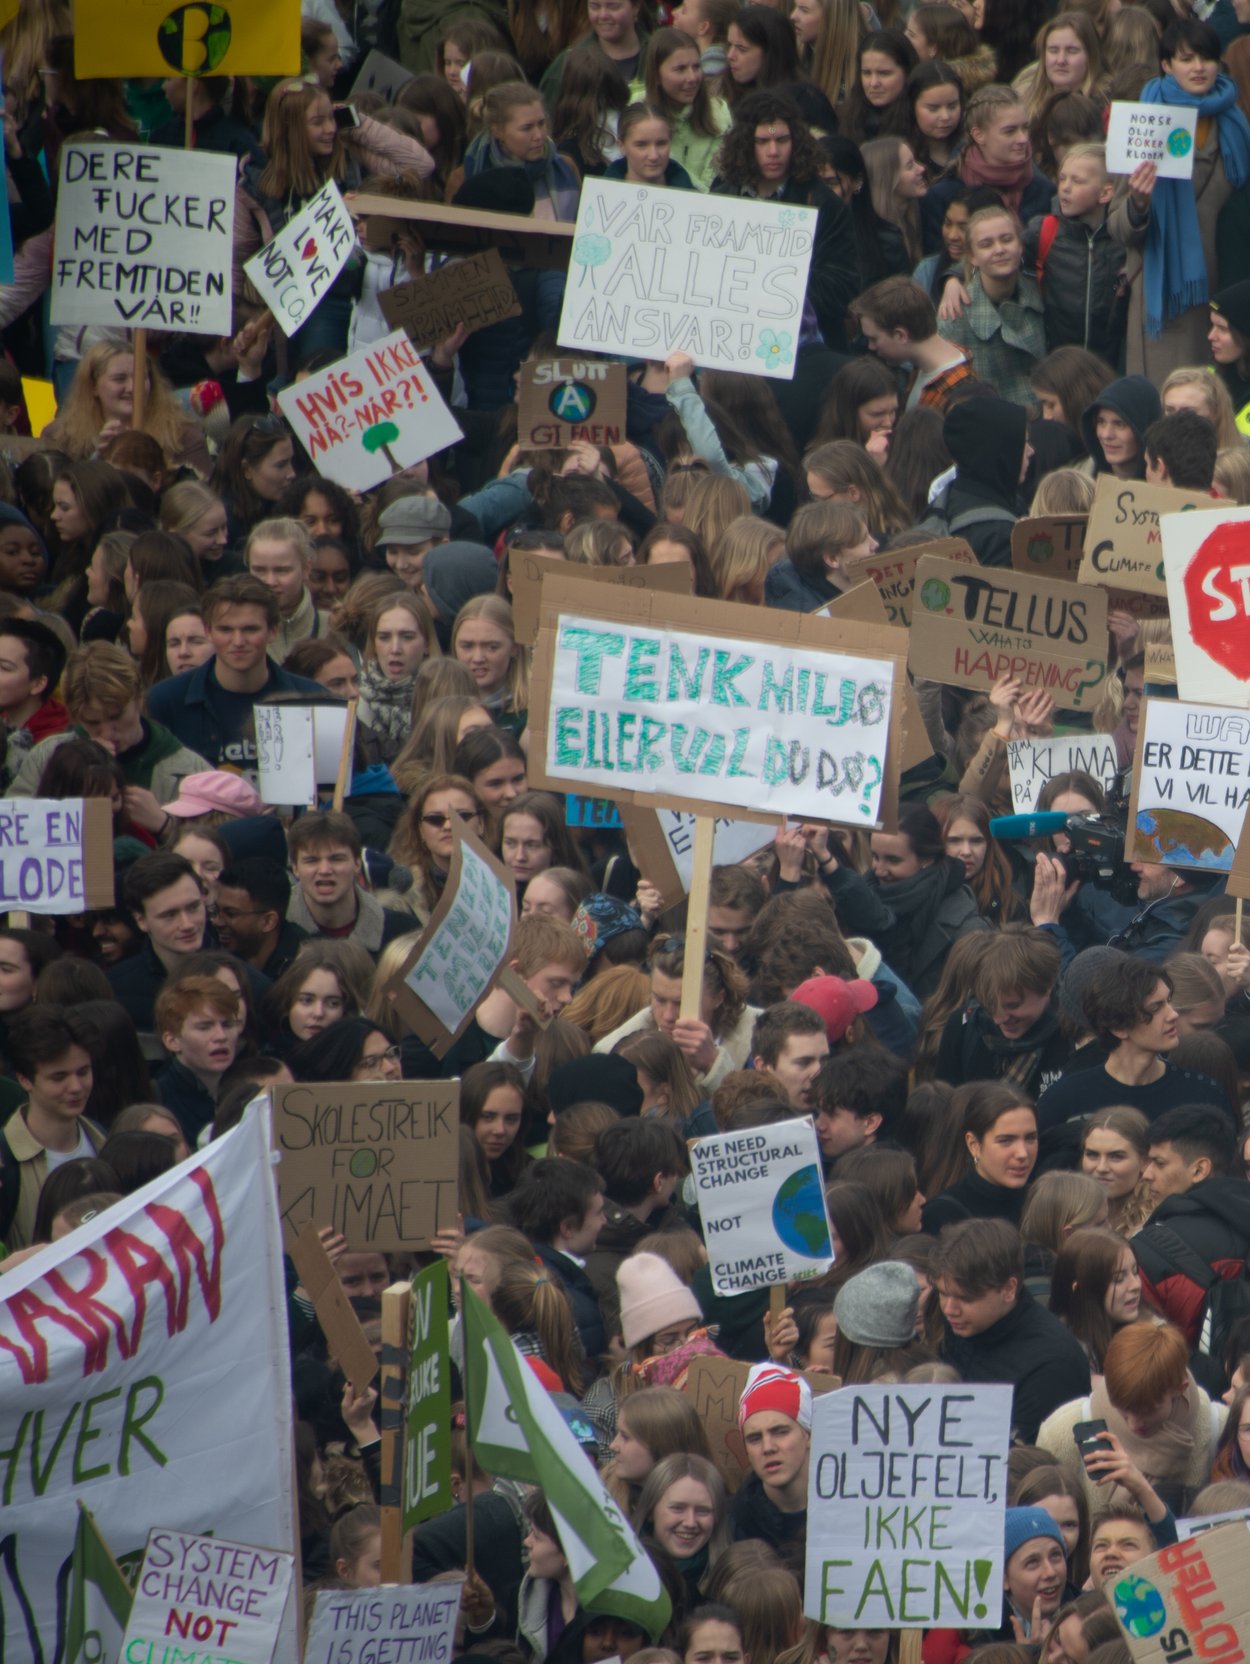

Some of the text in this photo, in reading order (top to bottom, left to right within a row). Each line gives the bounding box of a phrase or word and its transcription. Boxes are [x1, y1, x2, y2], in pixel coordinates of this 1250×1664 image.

[1127, 138, 1164, 149] KOKER
[65, 150, 161, 183] DERE
[92, 188, 227, 235] FUCKER
[307, 188, 351, 261] MAKE
[597, 189, 813, 258] VÅR FRAMTID
[74, 224, 153, 255] MED
[57, 259, 224, 296] FREMTIDEN
[257, 241, 295, 288] NOT
[602, 243, 800, 320] ALLES
[573, 296, 754, 361] ANSVAR!
[296, 338, 423, 428] HVIS IKKE
[532, 360, 610, 385] SLUTT
[557, 379, 588, 417] Å
[530, 425, 561, 445] GI
[866, 562, 904, 584] DET
[1091, 540, 1152, 573] CLIMATE
[951, 575, 1088, 644] TELLUS
[559, 627, 886, 728] TENK MILJØ
[555, 706, 668, 774] ELLER
[670, 723, 757, 779] VIL
[761, 732, 810, 786] DU
[1032, 745, 1118, 779] KLIMA
[1144, 742, 1173, 770] ER
[1180, 745, 1239, 775] DETTE
[1014, 780, 1032, 803] PÅ
[1154, 776, 1219, 805] VI VIL
[46, 811, 80, 845] EN
[280, 1088, 452, 1150] SKOLESTREIK
[331, 1148, 396, 1179] FOR
[694, 1136, 767, 1161] WE NEED
[697, 1144, 803, 1176] STRUCTURAL
[699, 1165, 769, 1189] CHANGE
[707, 1215, 742, 1234] NOT
[714, 1252, 785, 1276] CLIMATE
[717, 1267, 788, 1290] CHANGE
[851, 1395, 975, 1447] NYE
[815, 1452, 1001, 1504] OLJEFELT,
[864, 1505, 953, 1549] IKKE
[147, 1534, 280, 1585] SYSTEM
[141, 1571, 268, 1617] CHANGE
[819, 1559, 993, 1622] FAEN!
[164, 1607, 239, 1647] NOT
[330, 1600, 456, 1632] THIS PLANET
[358, 1632, 449, 1664] GETTING
